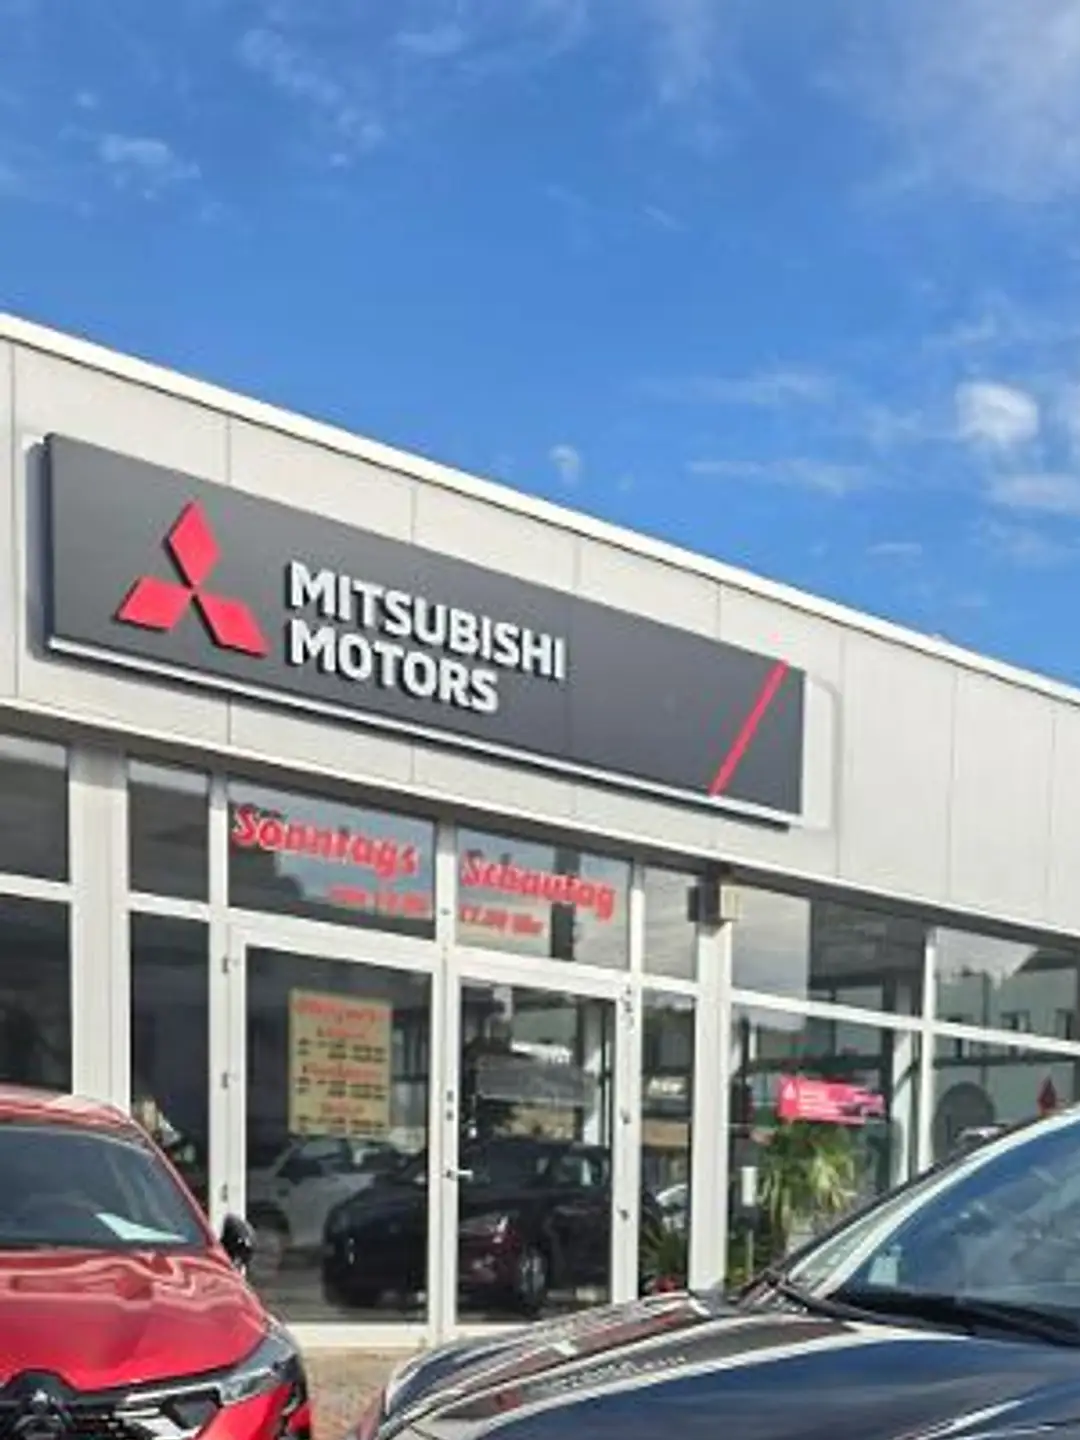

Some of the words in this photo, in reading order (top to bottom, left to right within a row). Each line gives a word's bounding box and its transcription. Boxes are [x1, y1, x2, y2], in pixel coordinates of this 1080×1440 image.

[290, 559, 567, 680] MITSUBISHI
[290, 617, 500, 714] MOTORS
[232, 803, 418, 879] Sonntags
